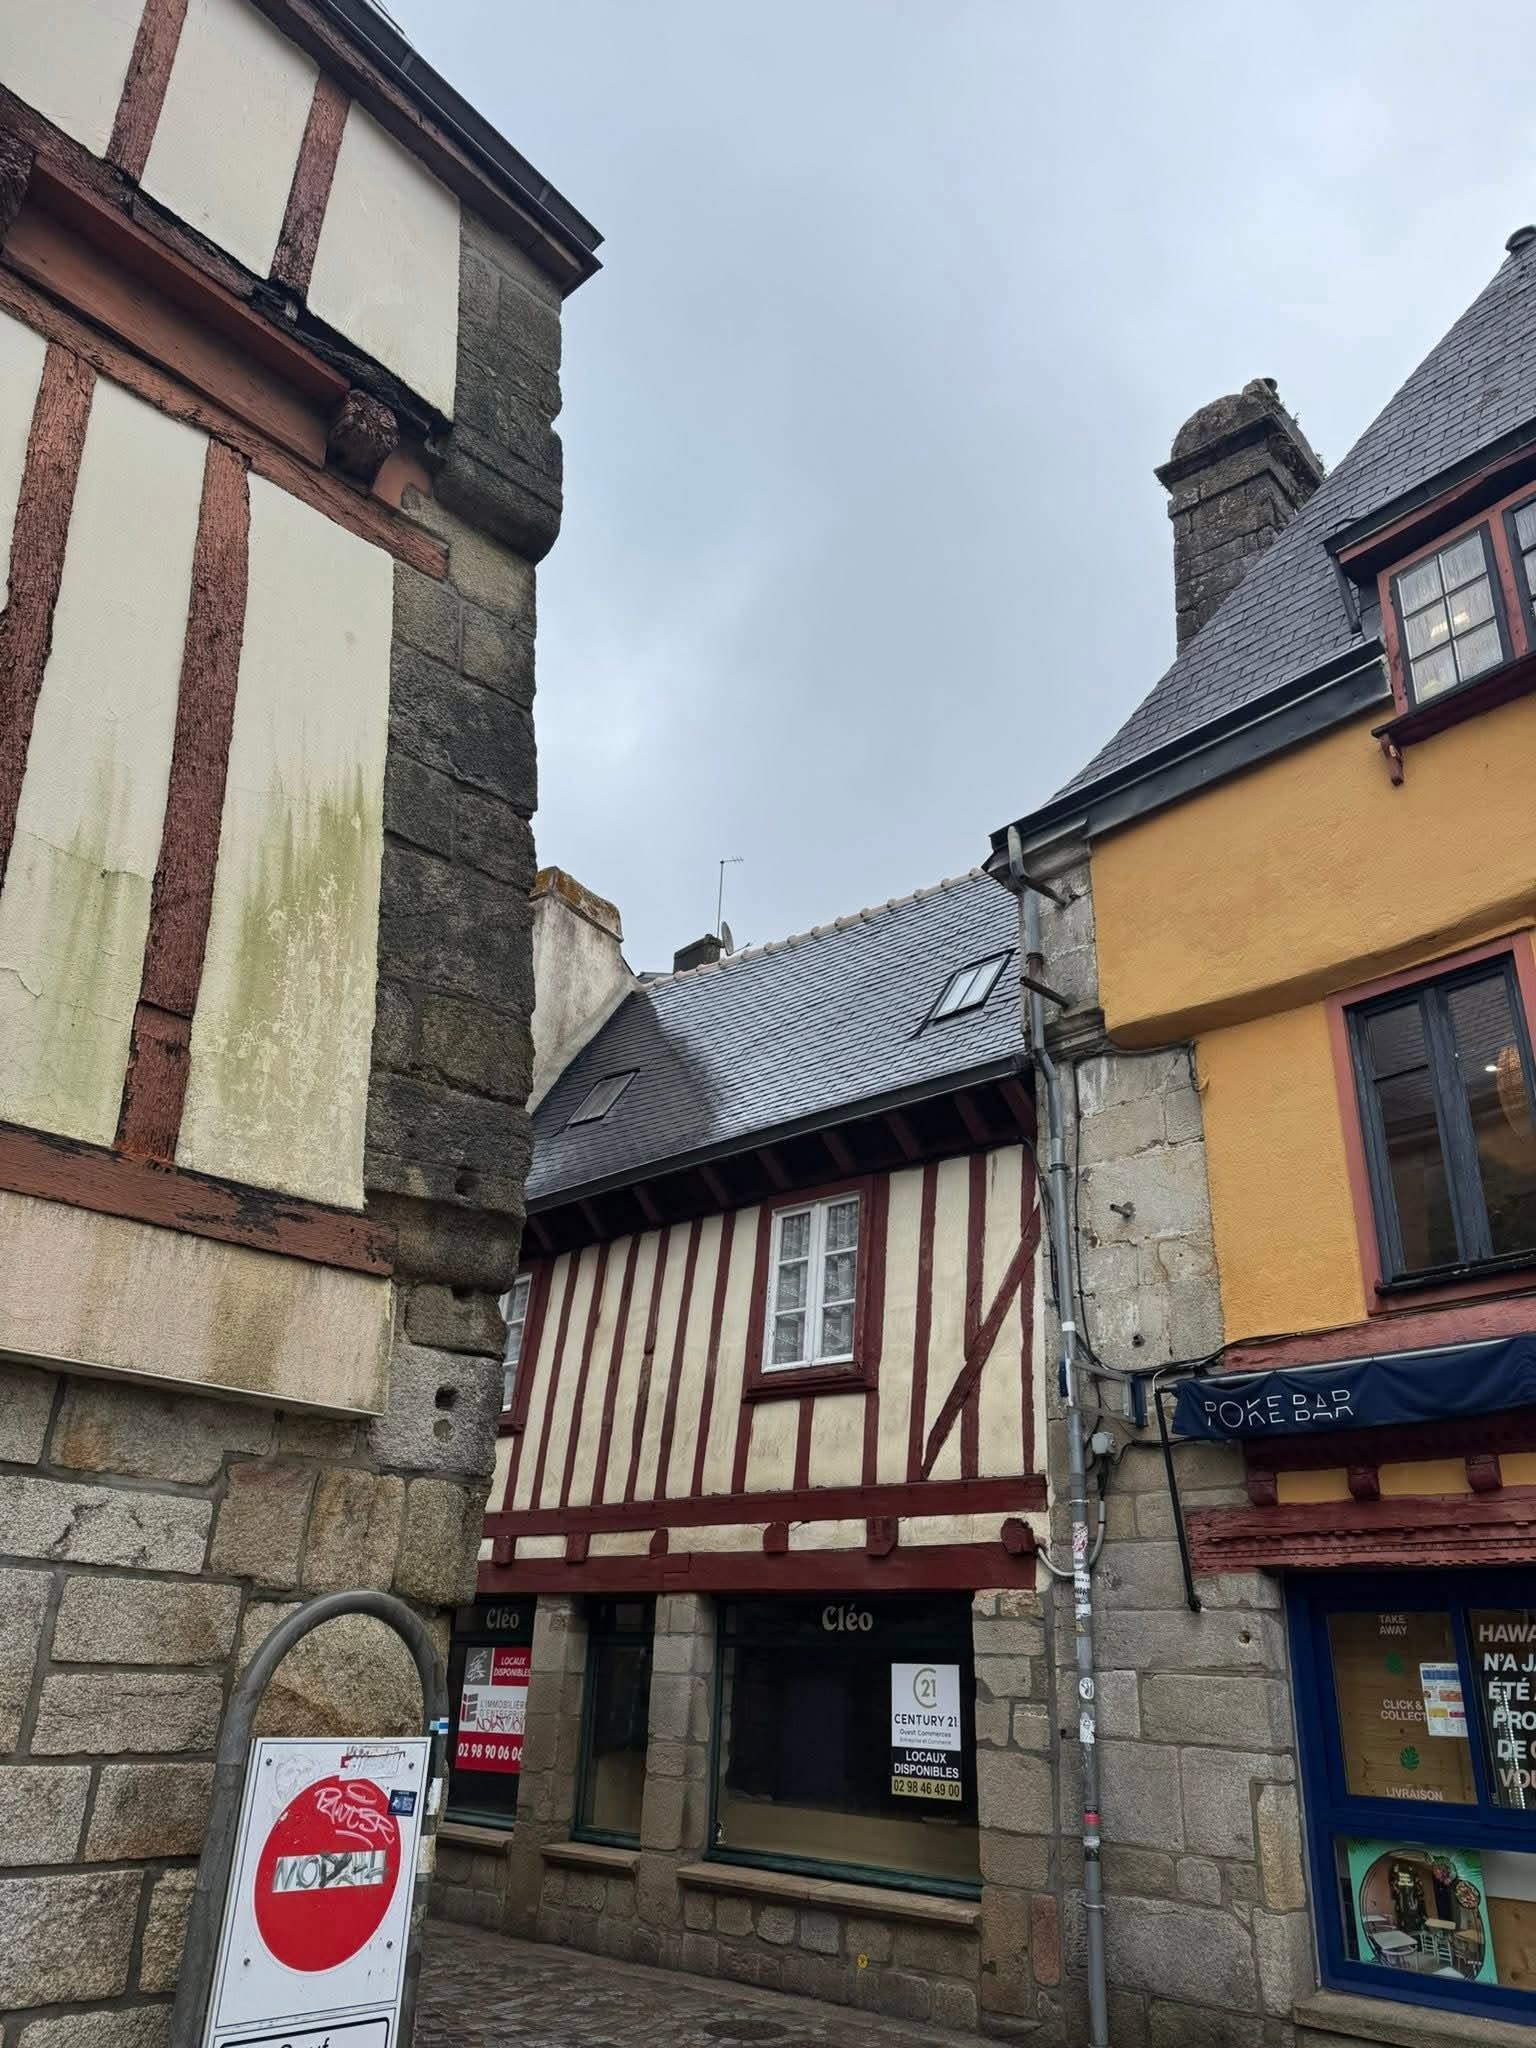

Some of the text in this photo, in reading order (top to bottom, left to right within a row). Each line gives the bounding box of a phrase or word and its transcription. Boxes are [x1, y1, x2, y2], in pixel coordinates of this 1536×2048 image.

[1204, 1389, 1355, 1428] POKE BAR
[487, 1608, 519, 1629] Cléo
[822, 1604, 873, 1631] Cléo
[1379, 1614, 1407, 1624] TAKE
[1378, 1625, 1408, 1635] AWAY
[500, 1656, 526, 1666] LOCAUX
[1488, 1676, 1531, 1701] ÉTÉ
[1383, 1699, 1424, 1711] CLICK &
[894, 1713, 958, 1728] CENTURY 21
[458, 1742, 470, 1758] 02
[471, 1743, 483, 1759] 98
[485, 1744, 497, 1760] 90
[497, 1745, 510, 1761] 06
[905, 1750, 947, 1764] LOCAUX
[1497, 1739, 1527, 1760] DE
[894, 1763, 959, 1778] DISPONIBLES
[894, 1779, 960, 1798] 02 98 46 49 00
[1385, 1787, 1444, 1801] LIVRAISON
